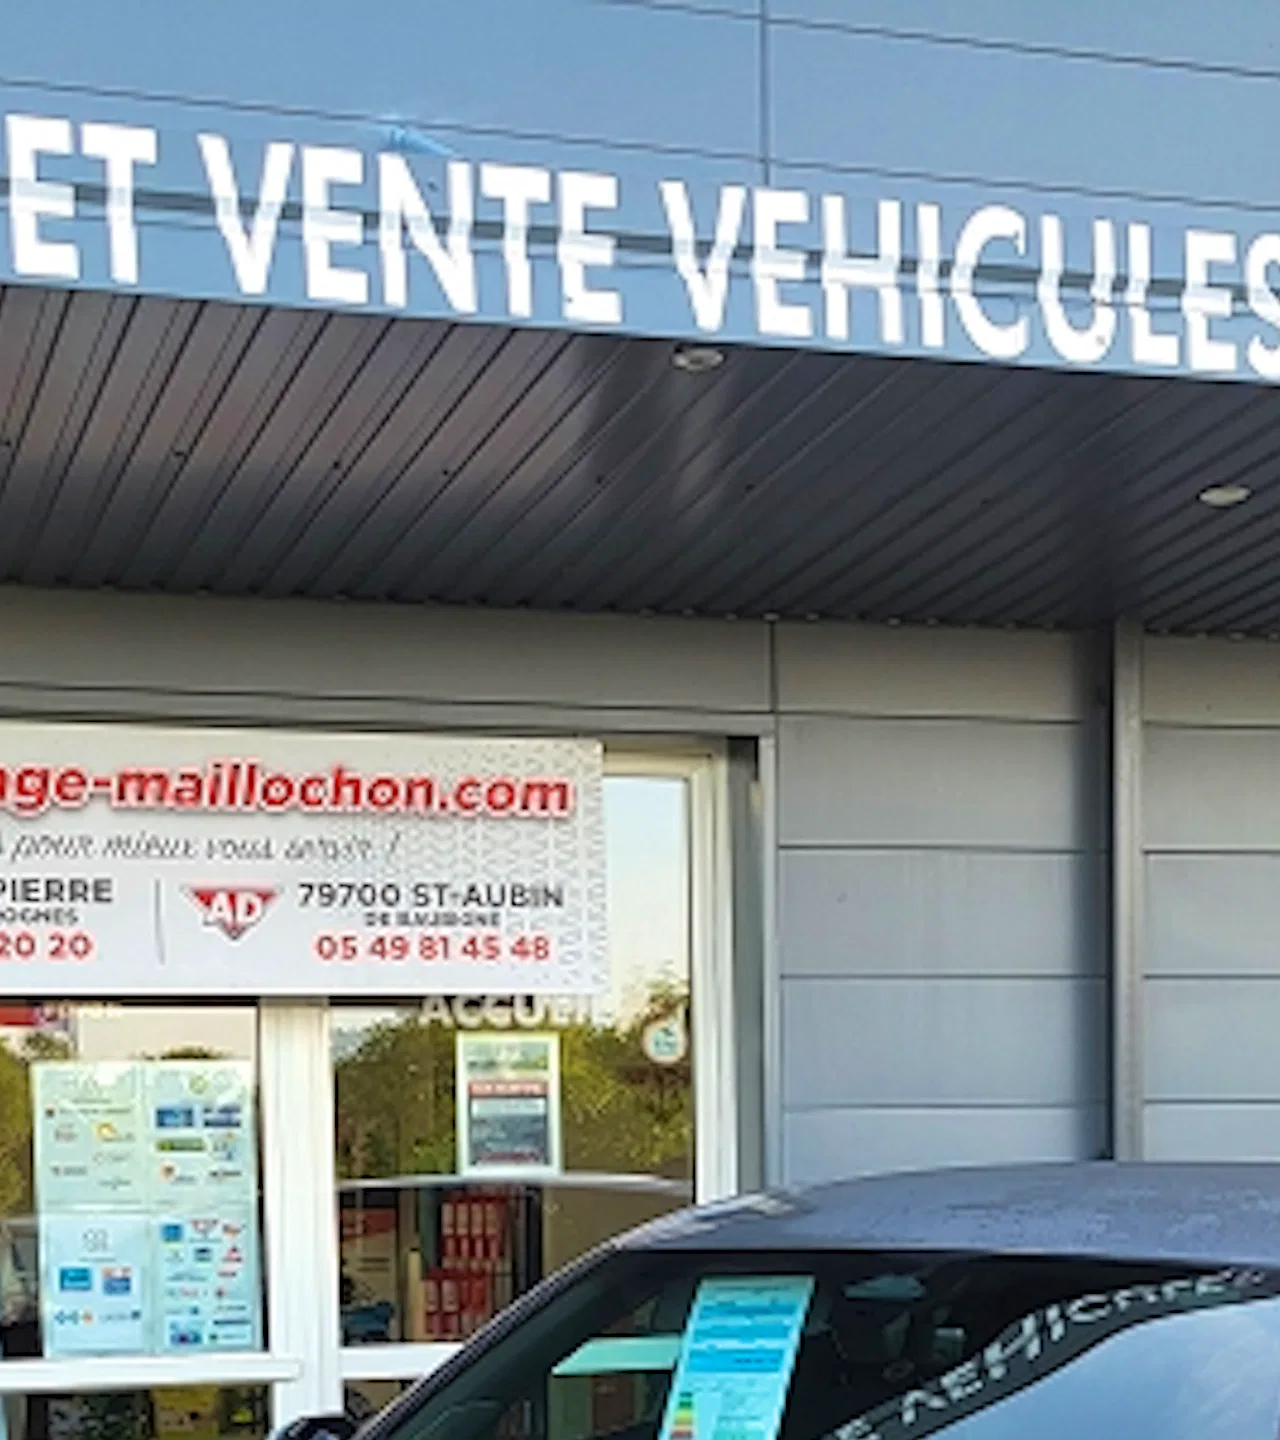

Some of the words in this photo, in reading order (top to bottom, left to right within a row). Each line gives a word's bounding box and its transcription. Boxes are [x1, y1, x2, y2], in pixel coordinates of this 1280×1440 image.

[4, 112, 158, 286] ET
[196, 132, 623, 324] VENTE
[9, 832, 94, 865] pour
[205, 890, 263, 923] AD
[298, 883, 401, 909] 79700
[412, 883, 565, 909] ST-AUBIN
[48, 932, 94, 961] 20
[316, 934, 359, 961] 05
[370, 934, 411, 961] 49
[418, 935, 451, 961] 81
[461, 935, 502, 961] 45
[510, 936, 551, 961] 48
